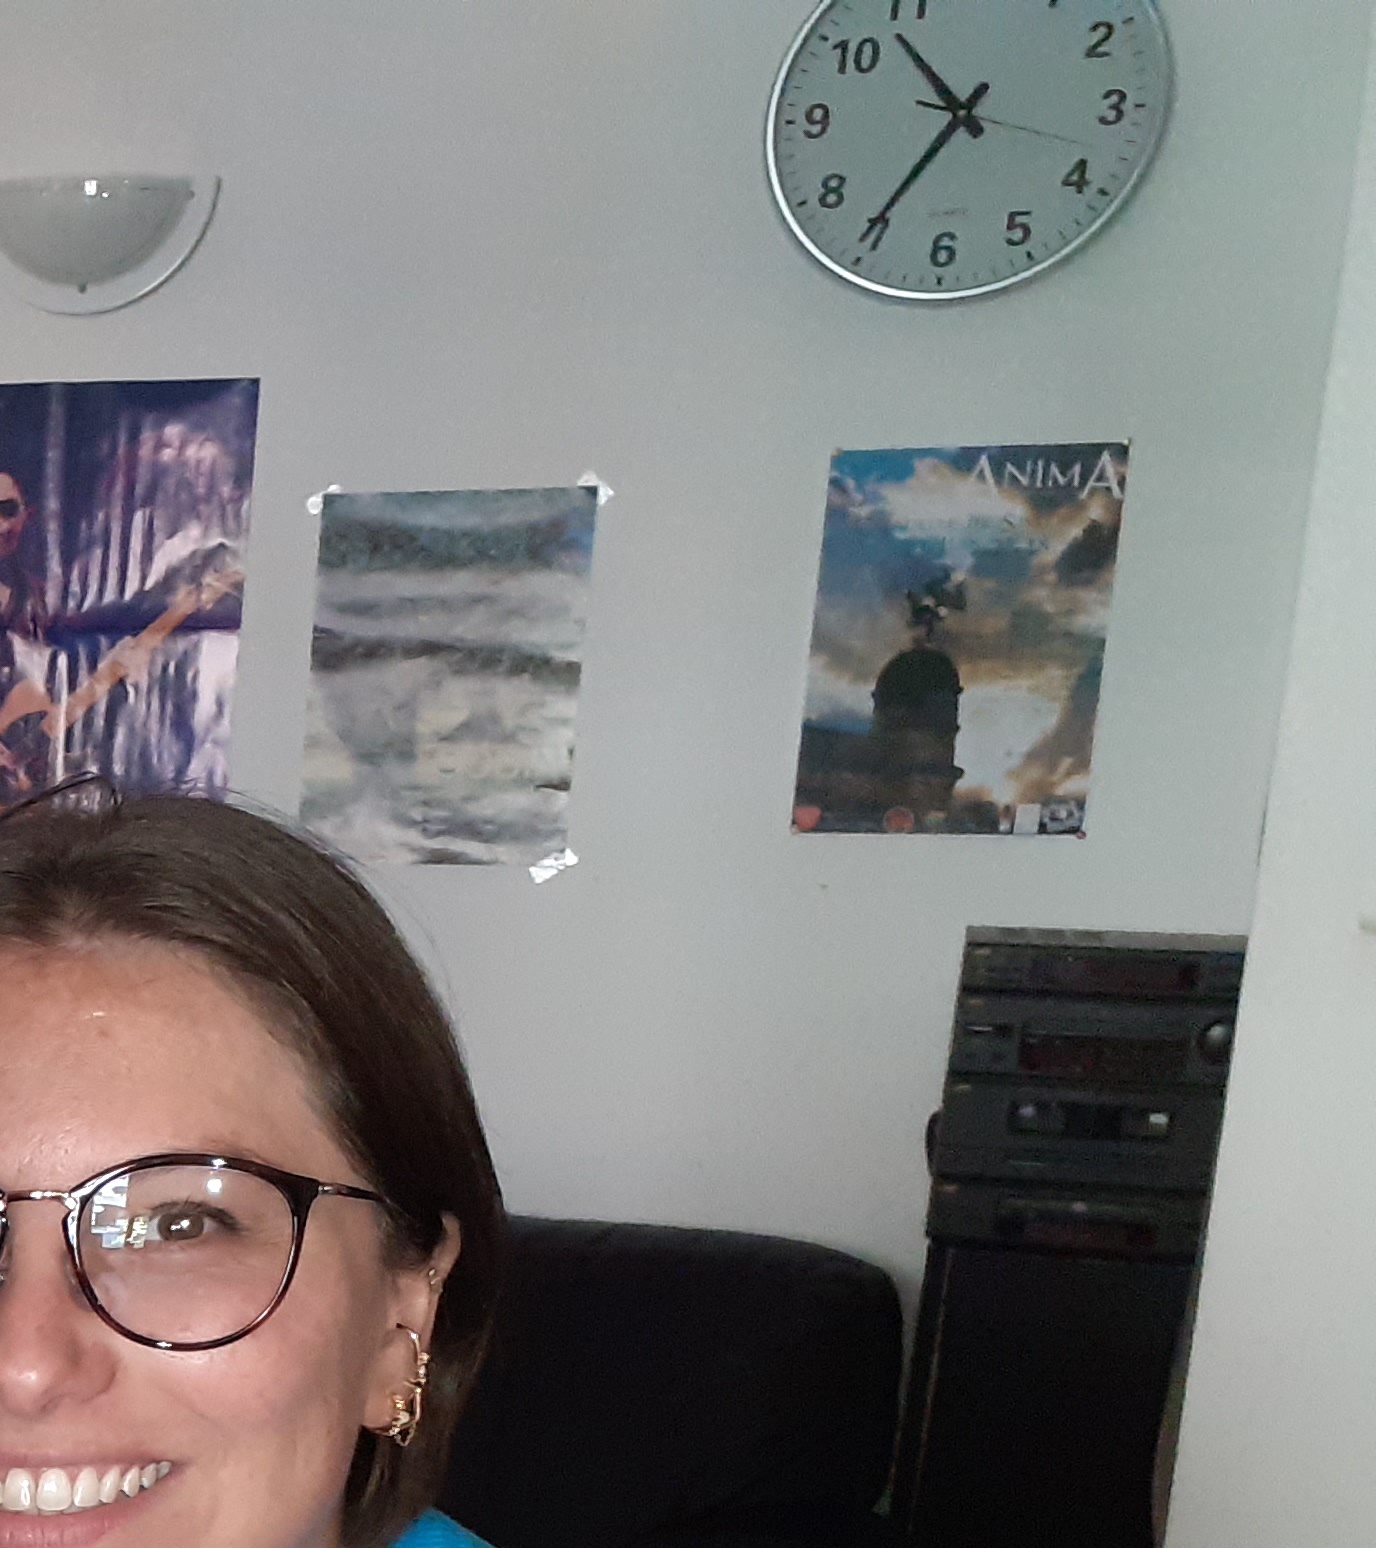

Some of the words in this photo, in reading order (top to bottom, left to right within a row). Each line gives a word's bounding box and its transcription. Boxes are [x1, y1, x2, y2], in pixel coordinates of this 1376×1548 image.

[831, 36, 881, 75] 10
[1084, 20, 1115, 59] 2
[802, 102, 830, 139] 9
[1098, 88, 1128, 126] 3
[818, 172, 847, 209] 8
[1061, 157, 1093, 195] 4
[1004, 210, 1033, 247] 5
[929, 230, 958, 268] 6
[969, 449, 1125, 501] ANIMA
